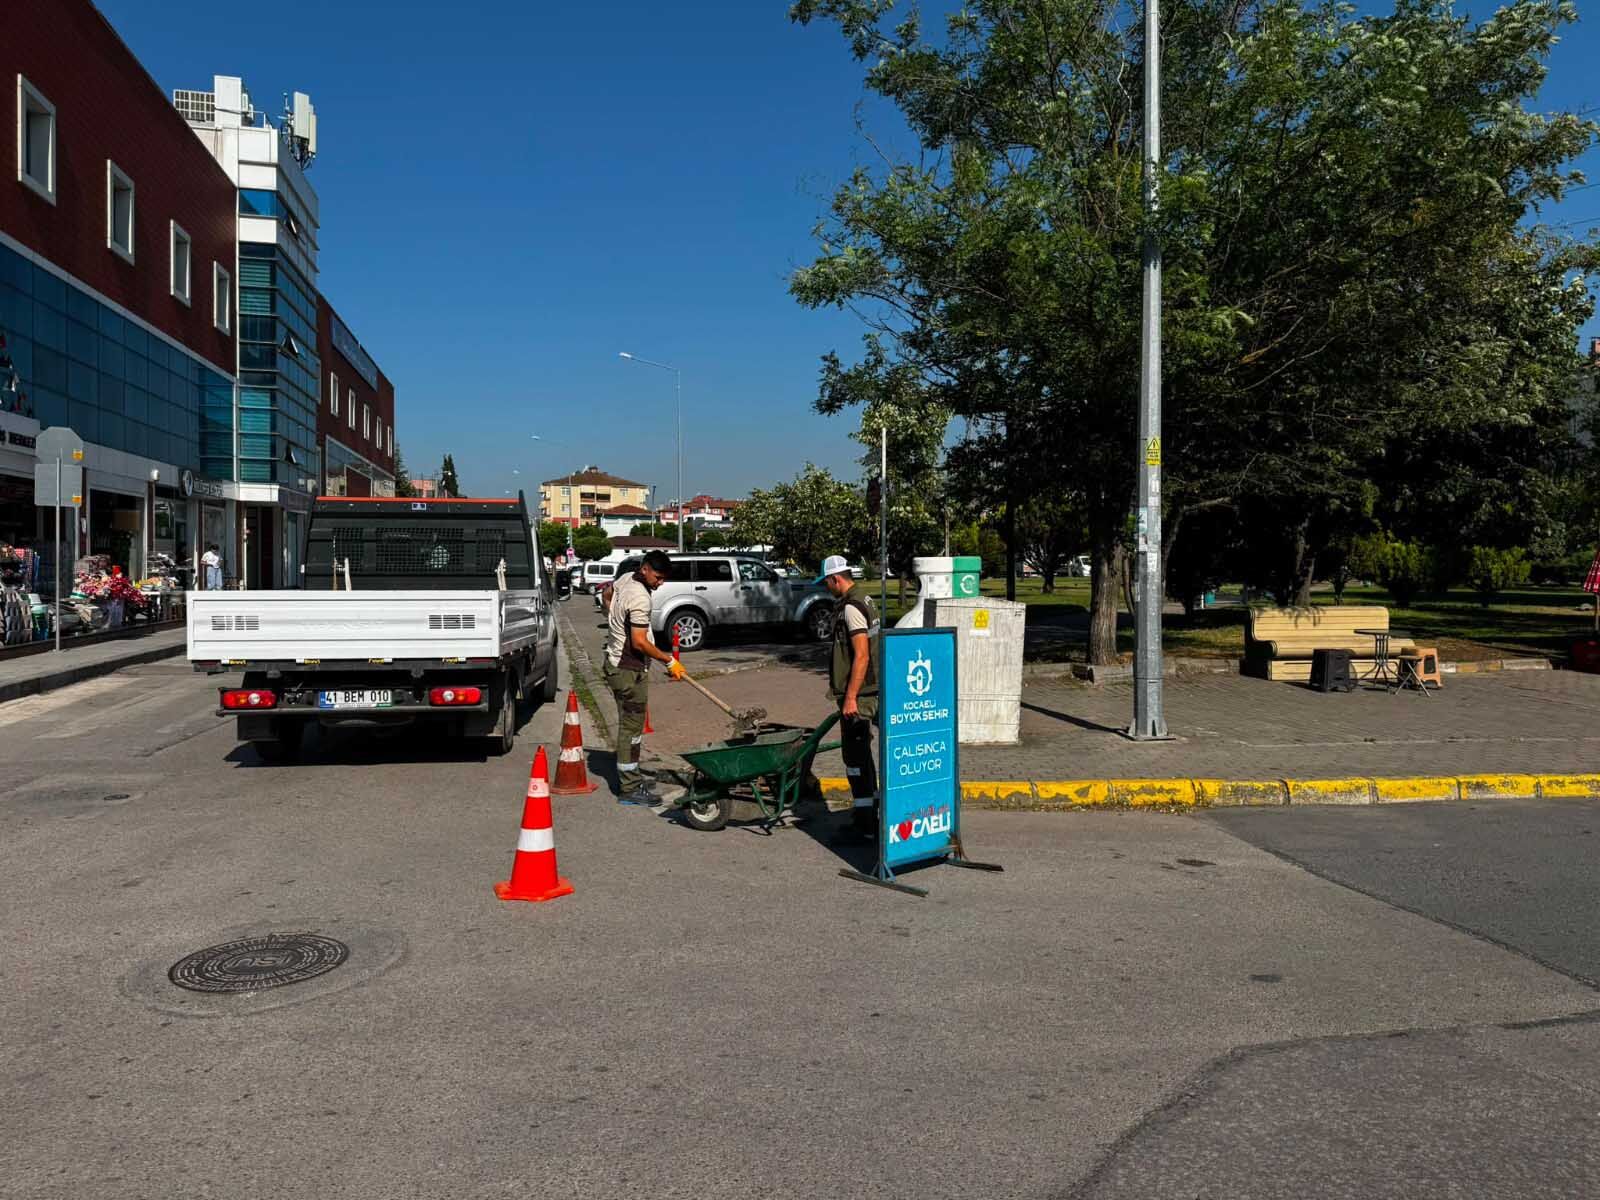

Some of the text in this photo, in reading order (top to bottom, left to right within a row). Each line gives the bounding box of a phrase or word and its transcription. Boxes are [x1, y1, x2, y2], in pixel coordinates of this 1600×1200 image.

[326, 689, 389, 703] 41 BEM 010
[899, 758, 942, 776] OLUYOR
